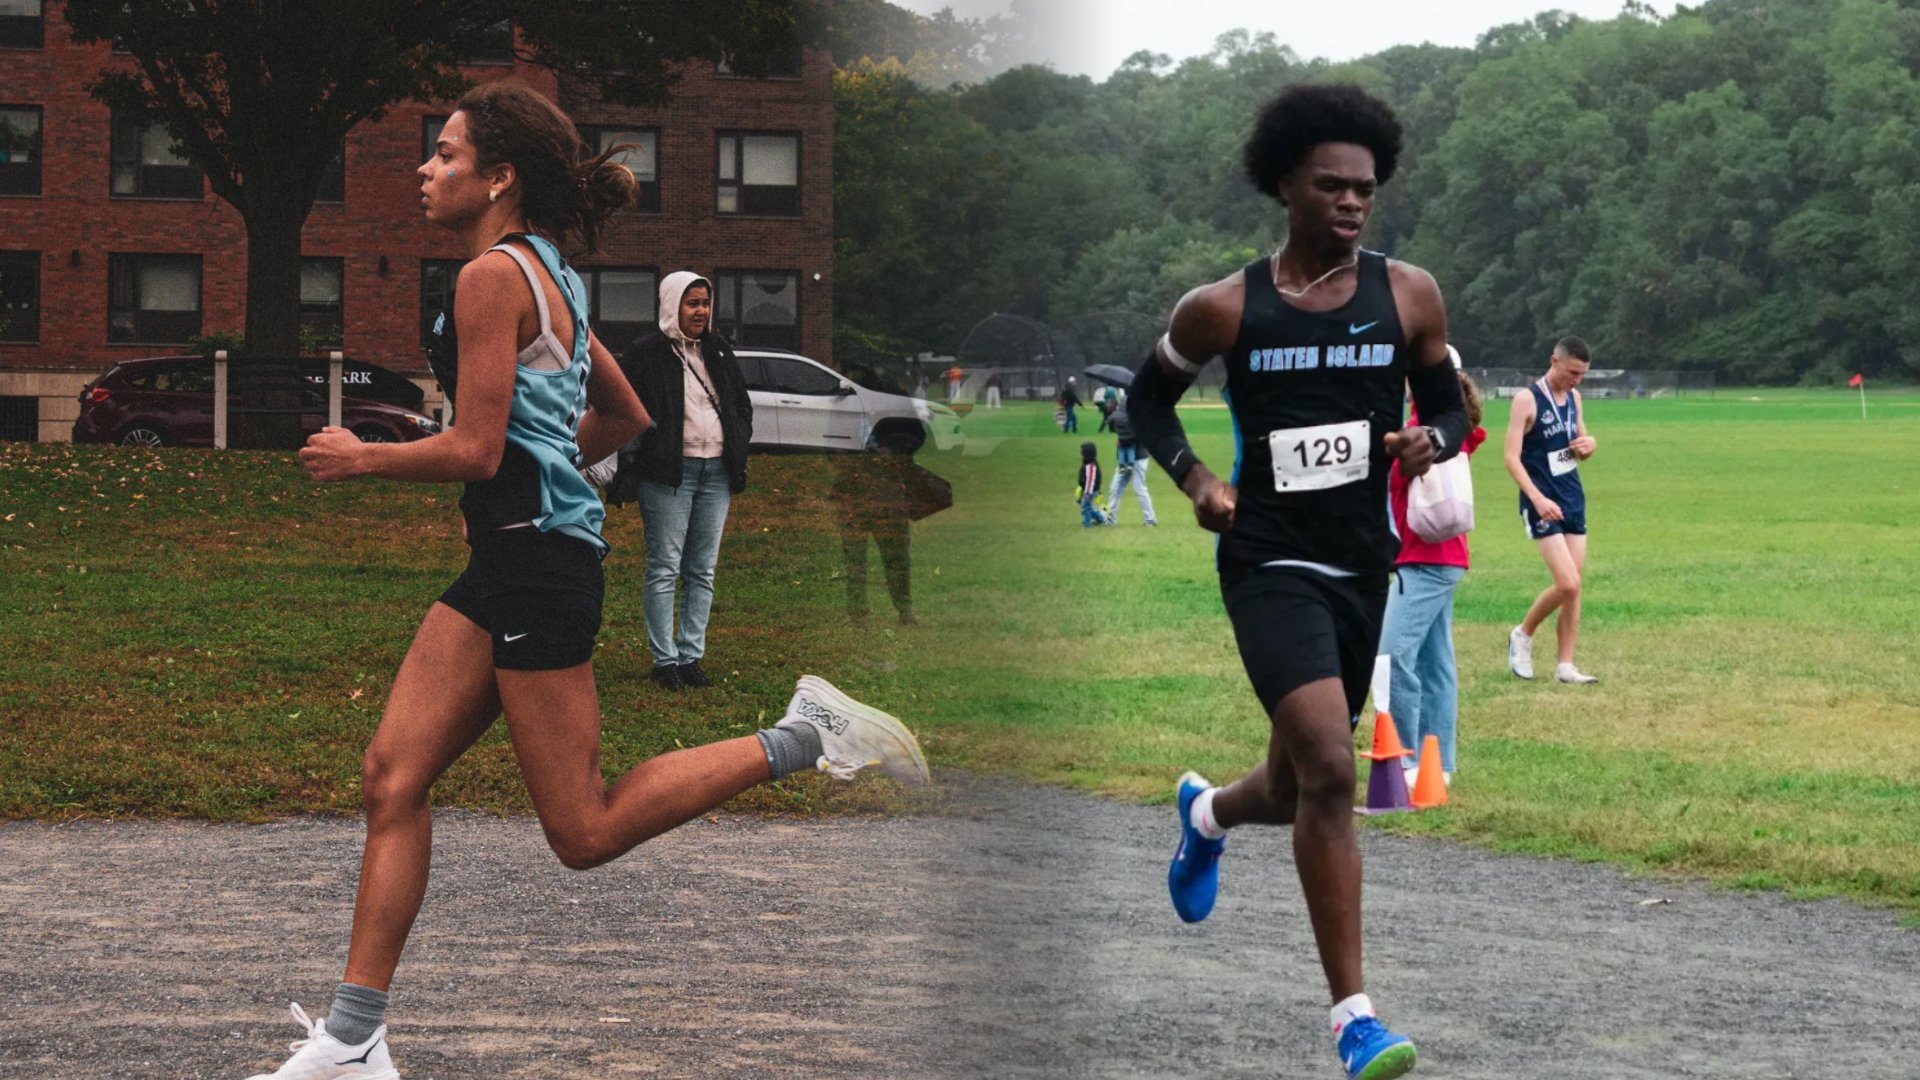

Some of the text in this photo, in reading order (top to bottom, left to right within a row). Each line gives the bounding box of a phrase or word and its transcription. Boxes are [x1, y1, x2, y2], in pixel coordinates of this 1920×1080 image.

[1250, 344, 1395, 372] STATEN ISLAND
[1293, 435, 1352, 468] 129
[797, 698, 849, 736] HOKA
